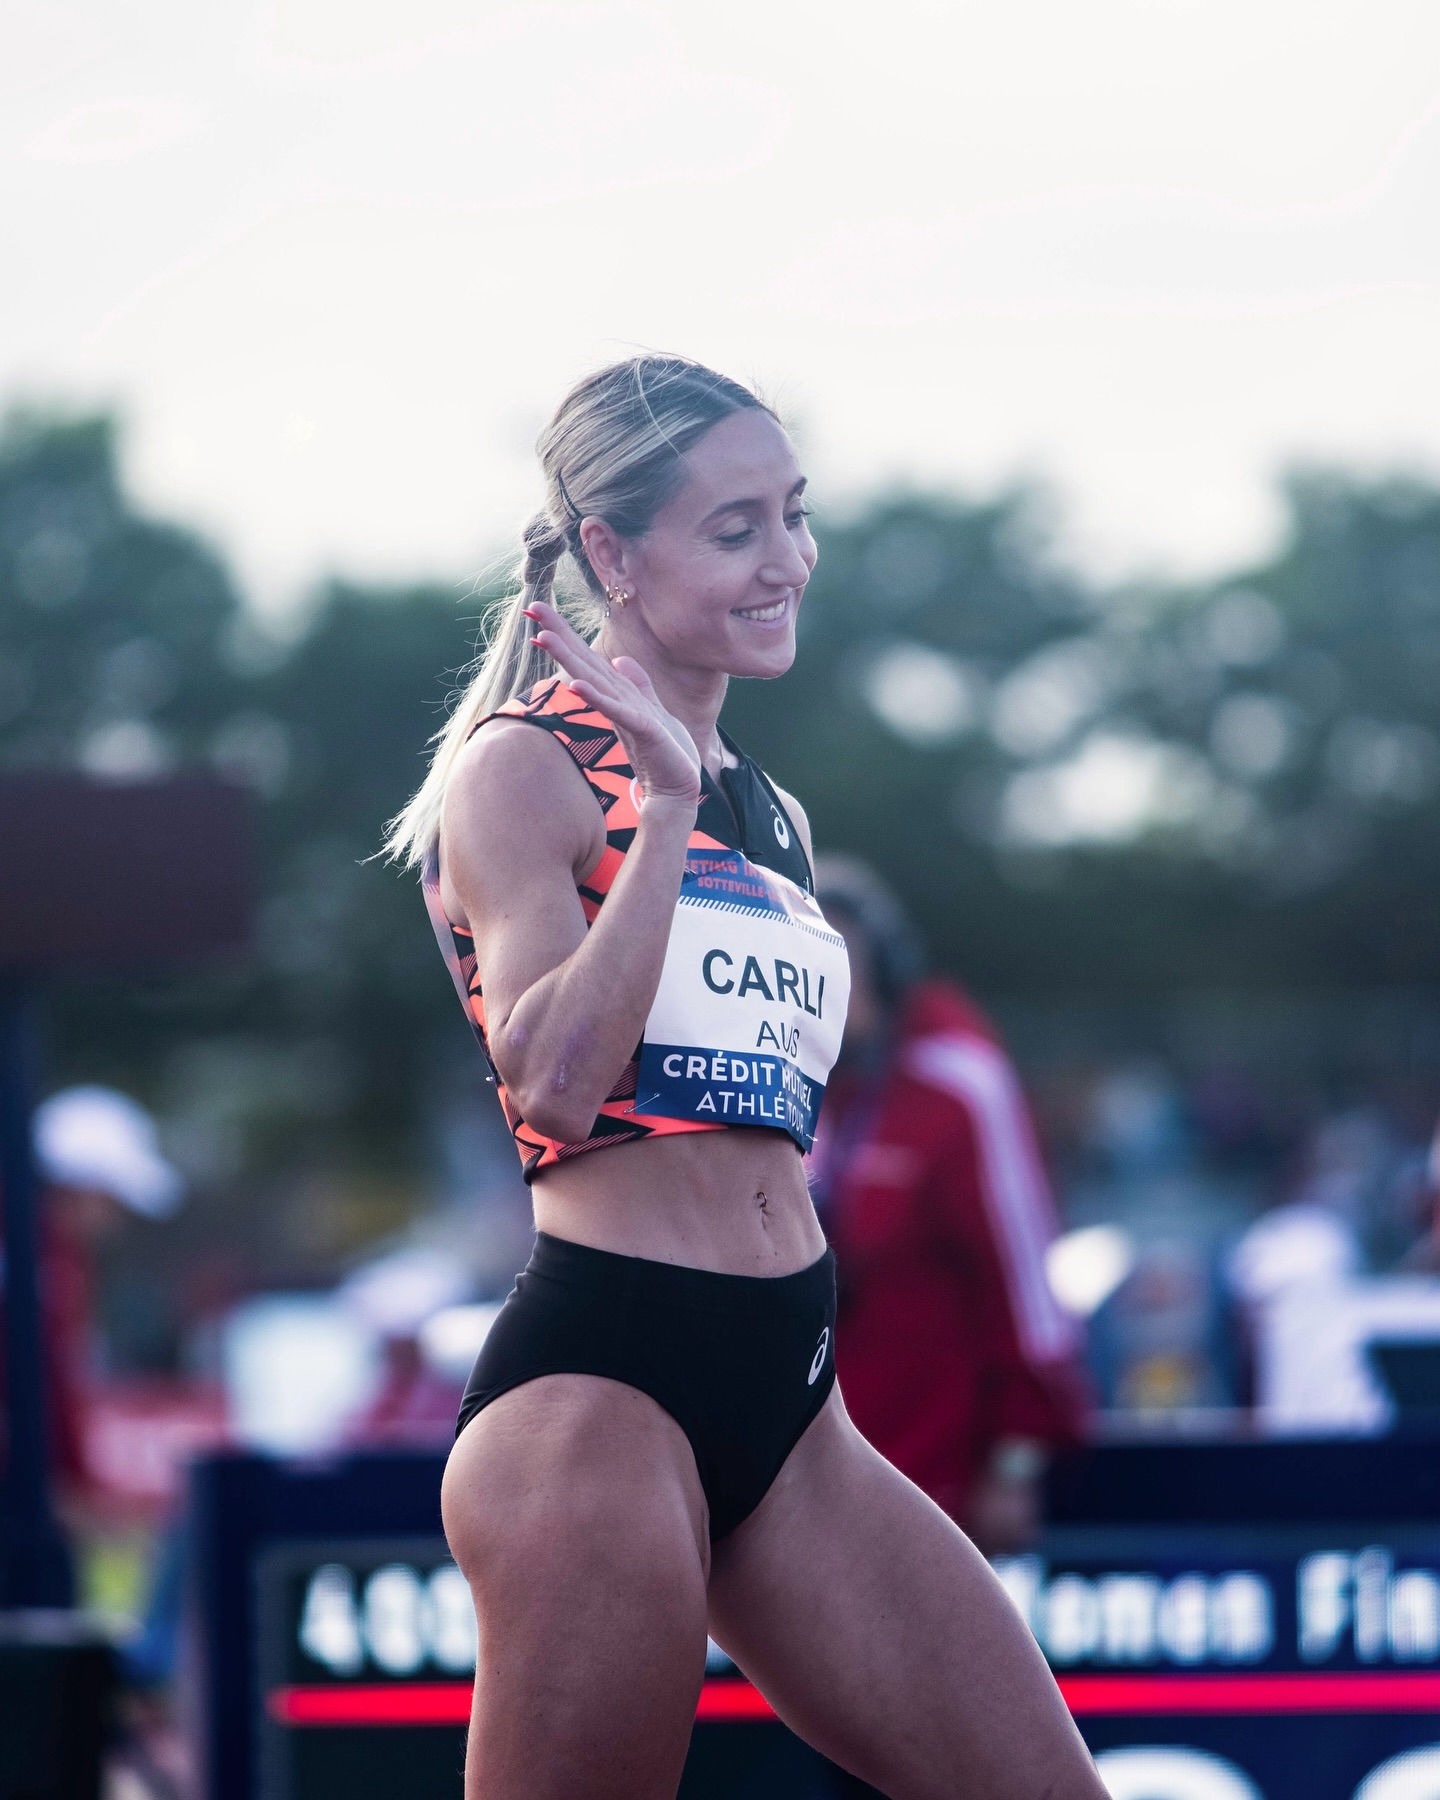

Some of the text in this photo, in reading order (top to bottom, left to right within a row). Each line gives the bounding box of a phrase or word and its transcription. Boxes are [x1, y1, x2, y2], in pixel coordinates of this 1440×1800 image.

[702, 948, 825, 1020] CARLI
[756, 1020, 800, 1058] AUS
[662, 1051, 776, 1086] CRÉDIT
[695, 1090, 785, 1120] ATHLÉ
